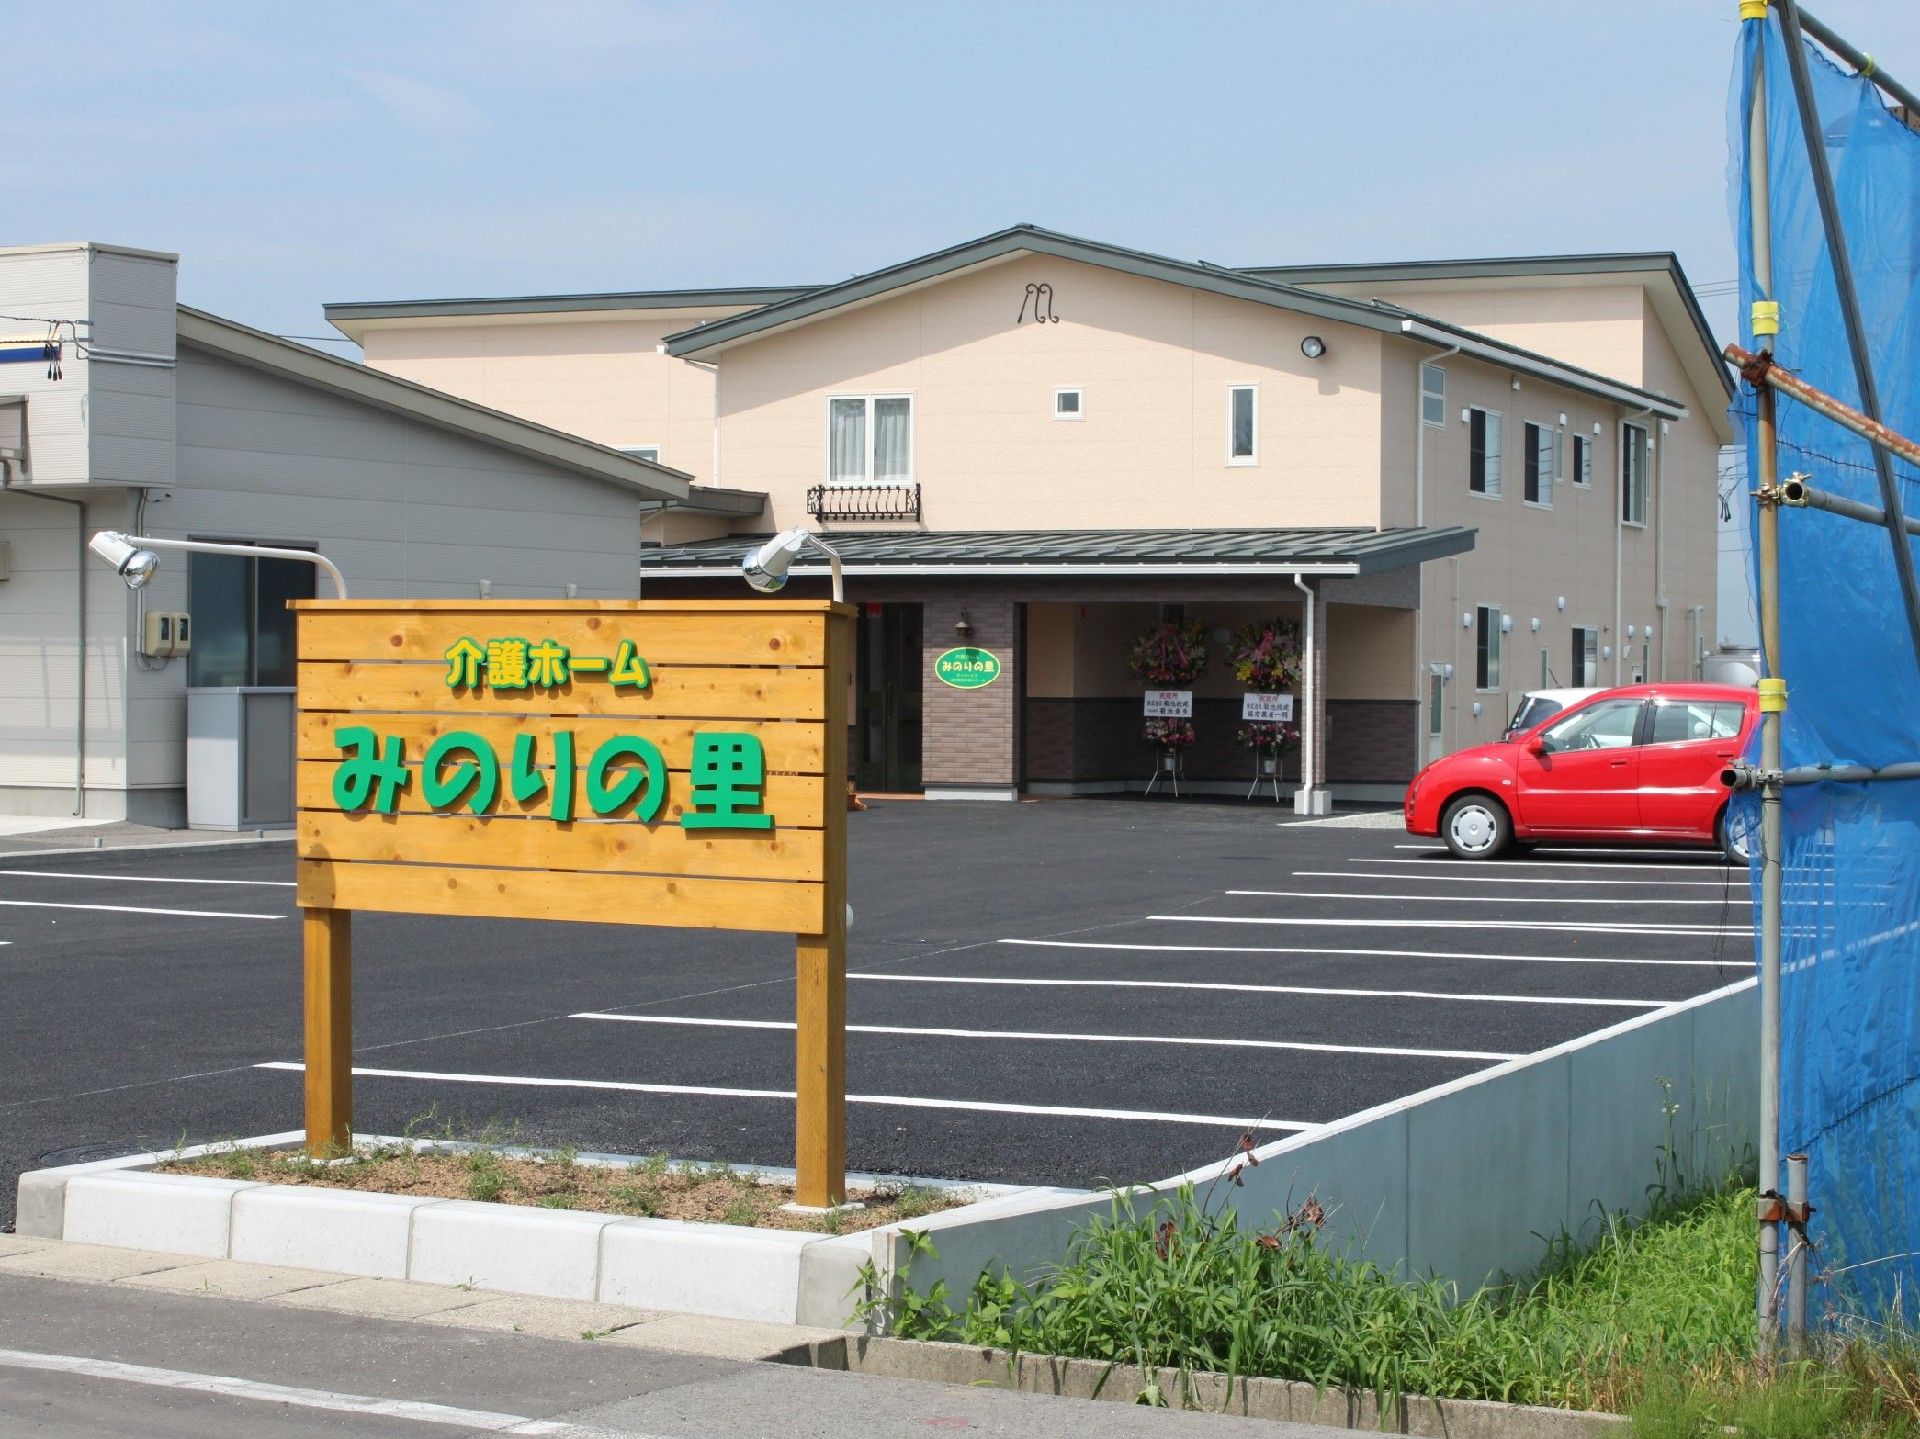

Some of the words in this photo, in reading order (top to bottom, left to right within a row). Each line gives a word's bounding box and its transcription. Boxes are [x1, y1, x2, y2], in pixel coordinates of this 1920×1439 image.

[446, 637, 650, 688] 介護ホーム
[942, 660, 995, 673] みのりの里
[333, 726, 775, 829] みのりの里
